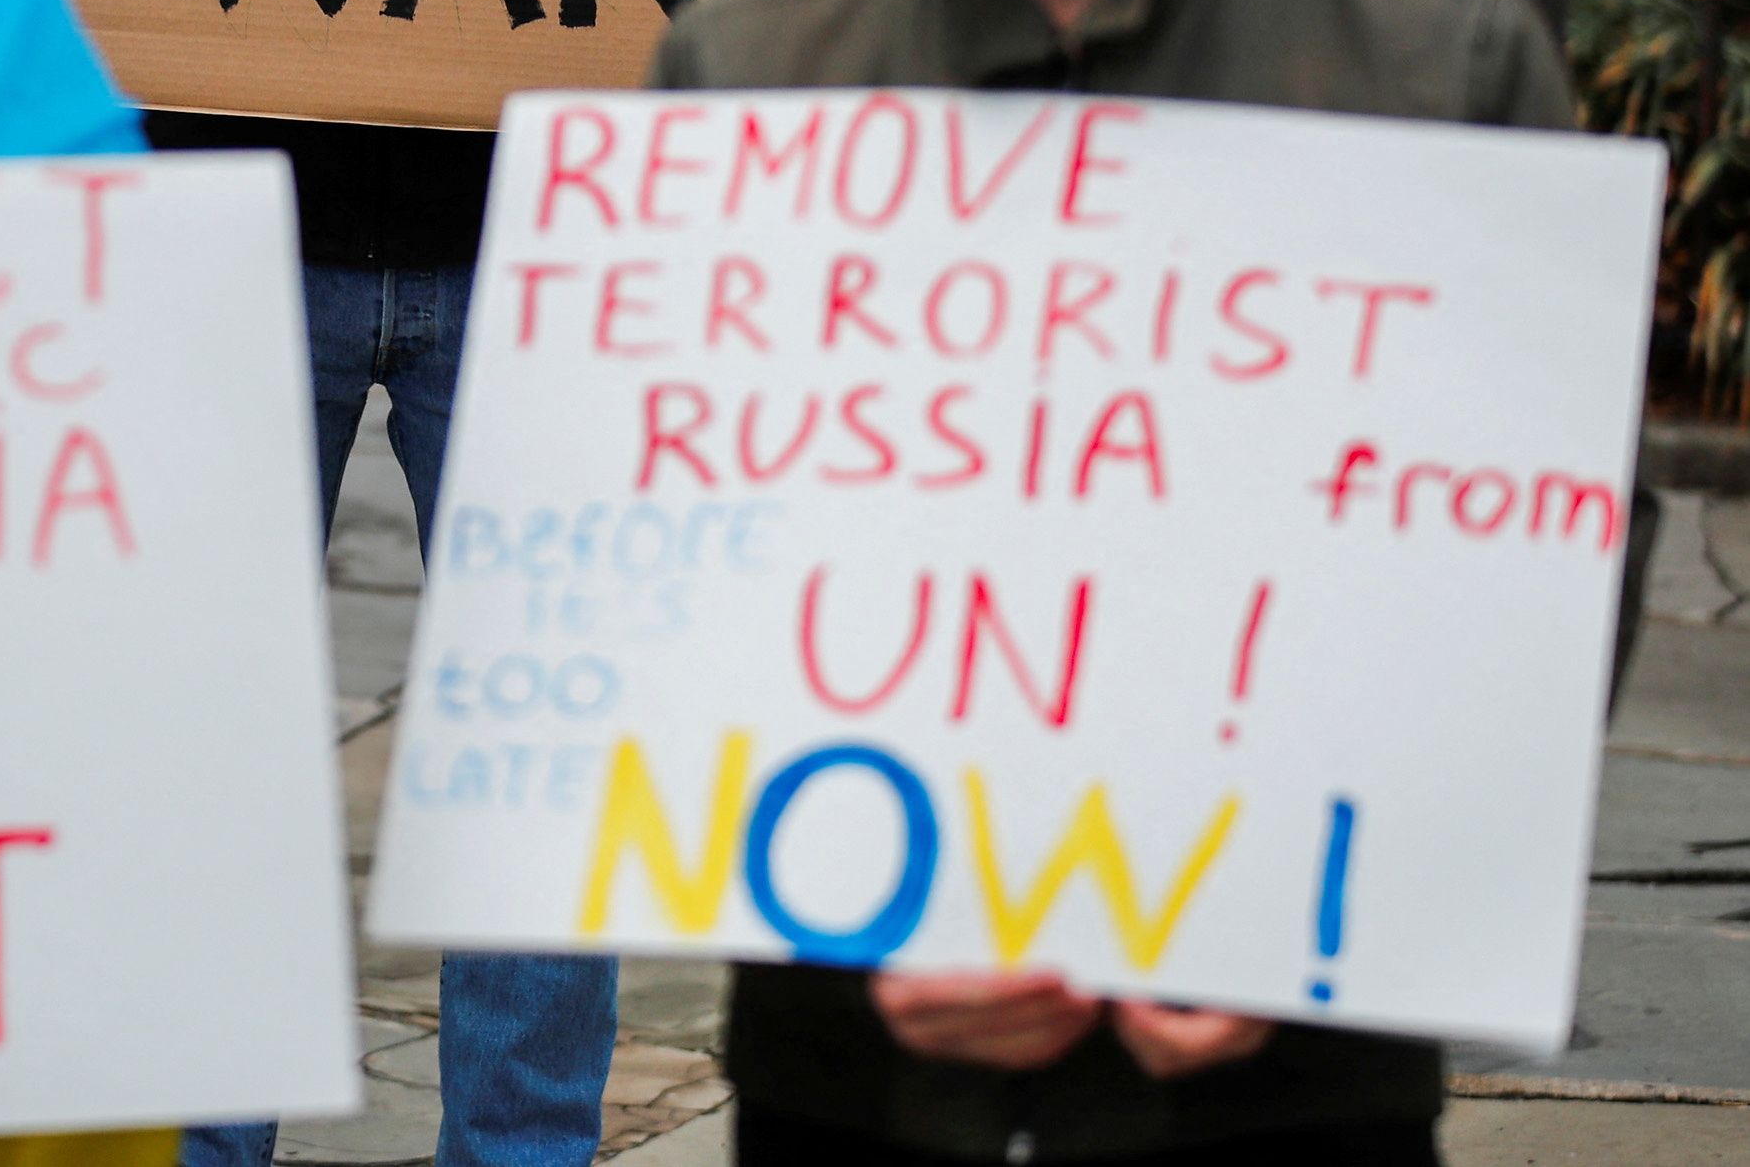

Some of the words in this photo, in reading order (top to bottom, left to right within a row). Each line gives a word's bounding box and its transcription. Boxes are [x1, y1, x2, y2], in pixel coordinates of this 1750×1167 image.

[536, 89, 1148, 234] REMOVE
[1308, 439, 1629, 559] from
[795, 566, 1096, 733] UN
[402, 737, 599, 811] LATE
[577, 727, 1242, 973] NOW
